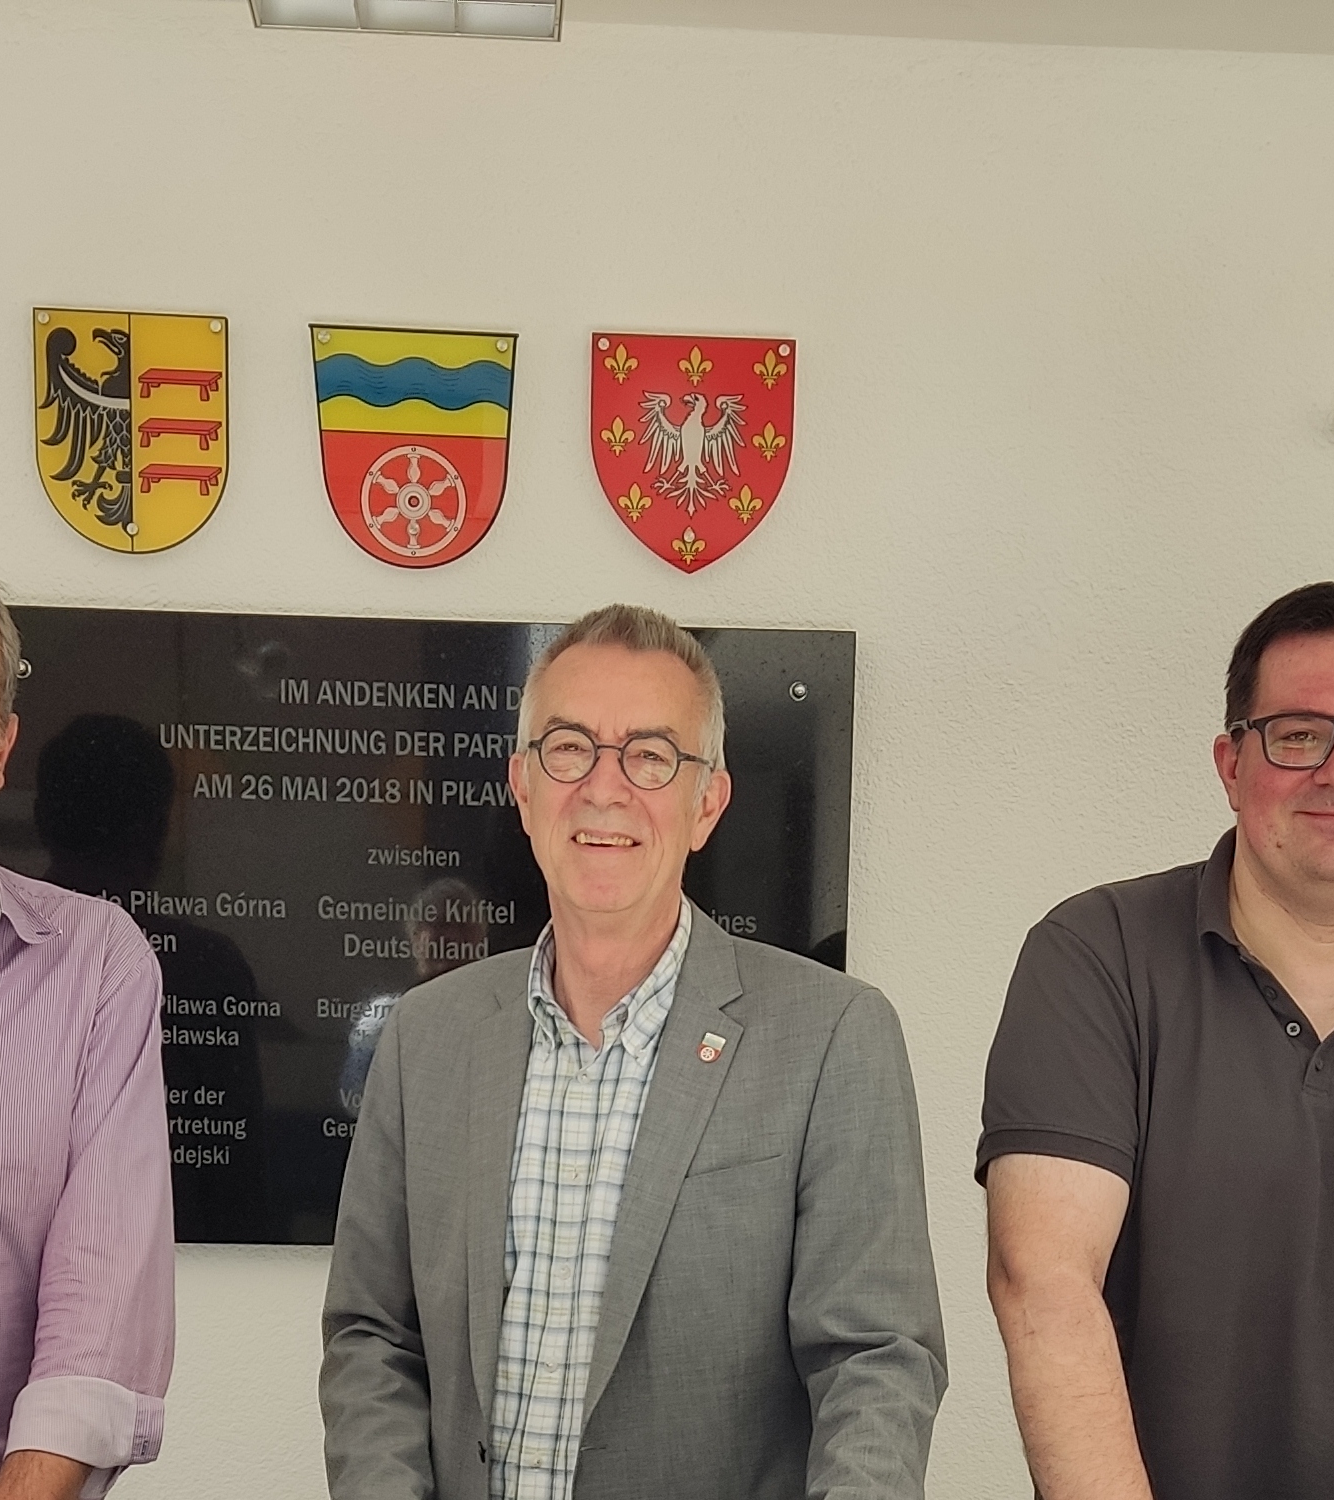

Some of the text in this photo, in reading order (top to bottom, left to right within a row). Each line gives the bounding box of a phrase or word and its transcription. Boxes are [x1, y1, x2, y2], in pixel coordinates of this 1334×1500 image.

[279, 678, 310, 705] IM
[316, 680, 456, 710] ANDENKEN
[462, 684, 498, 711] AN
[159, 723, 517, 759] UNTERZEICHNUNG DER PART
[193, 773, 517, 807] AM 26 MAI 2018 IN PIŁAW
[367, 845, 460, 867] zwischen
[130, 889, 208, 917] Piława
[216, 891, 287, 919] Górna
[317, 895, 516, 925] Gemeinde Kriftel
[223, 995, 282, 1018] Gorna
[161, 1025, 240, 1047] elawska
[193, 1085, 227, 1106] der
[169, 1117, 247, 1140] rtretung
[171, 1146, 231, 1168] dejski
